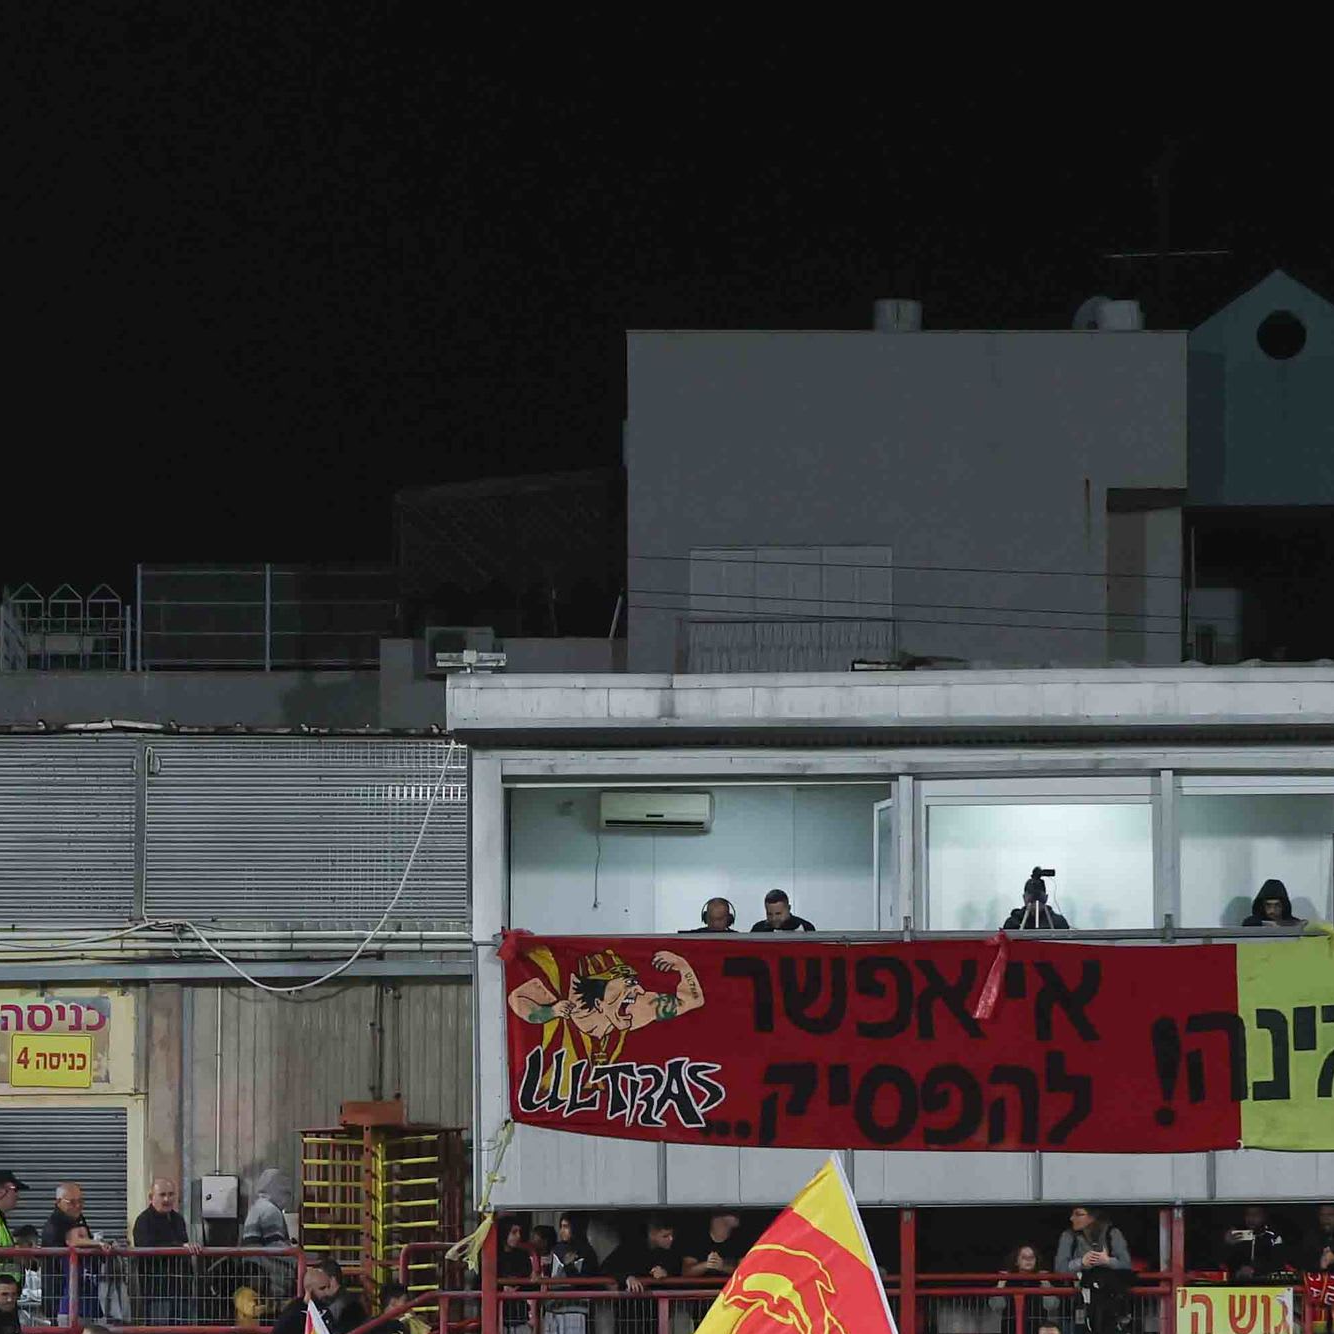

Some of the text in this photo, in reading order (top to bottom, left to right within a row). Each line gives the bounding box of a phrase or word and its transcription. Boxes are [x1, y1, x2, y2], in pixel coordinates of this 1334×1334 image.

[0, 1003, 106, 1032] כניסה
[724, 956, 985, 1042] אפשר
[16, 1046, 87, 1071] כניסה 4
[518, 1045, 725, 1128] ULTRAS
